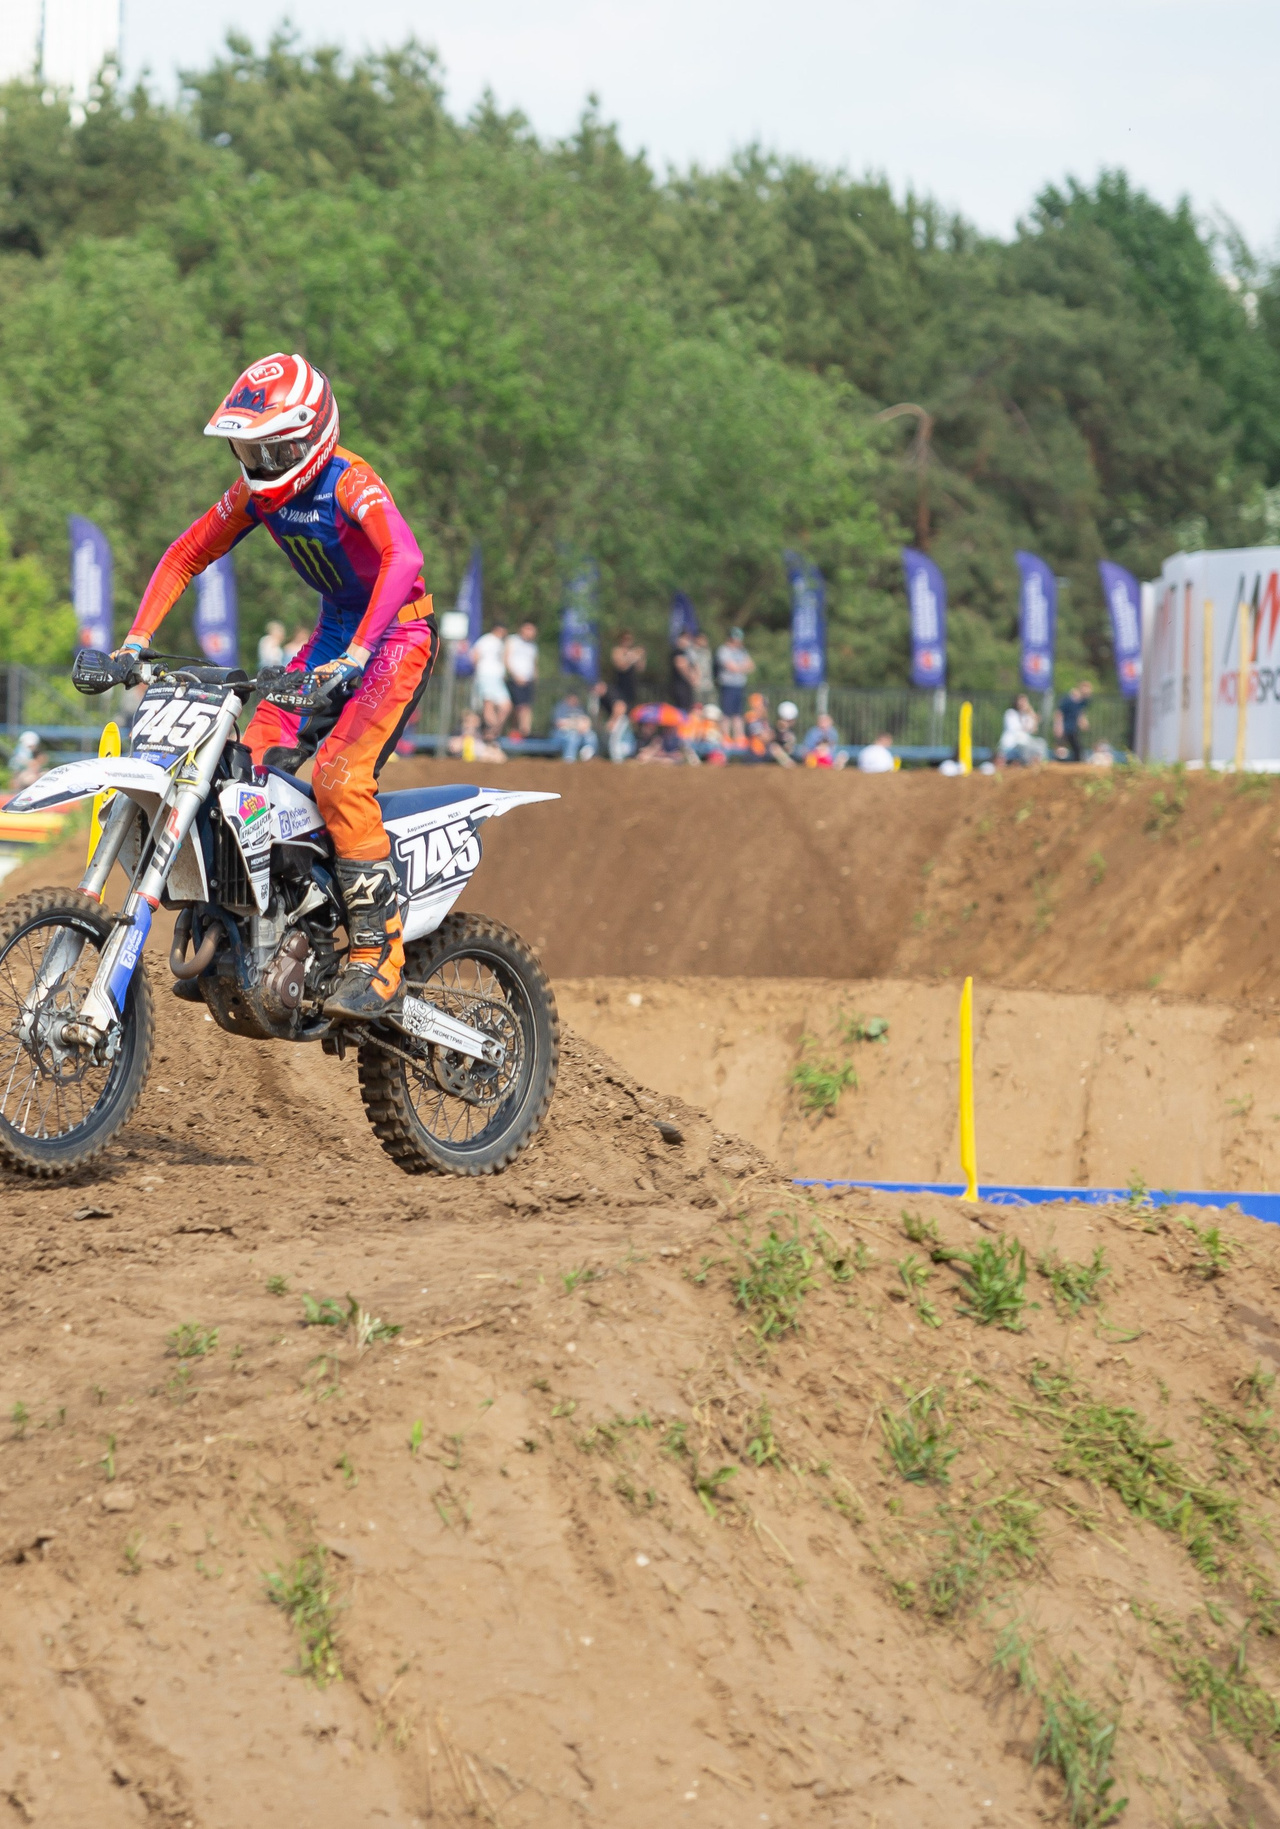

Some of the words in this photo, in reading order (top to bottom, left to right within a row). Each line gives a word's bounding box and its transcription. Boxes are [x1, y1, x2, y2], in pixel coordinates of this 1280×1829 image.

[265, 692, 315, 706] ACERBIS
[132, 699, 220, 747] 745
[292, 816, 312, 831] Кредит
[400, 819, 480, 891] 745
